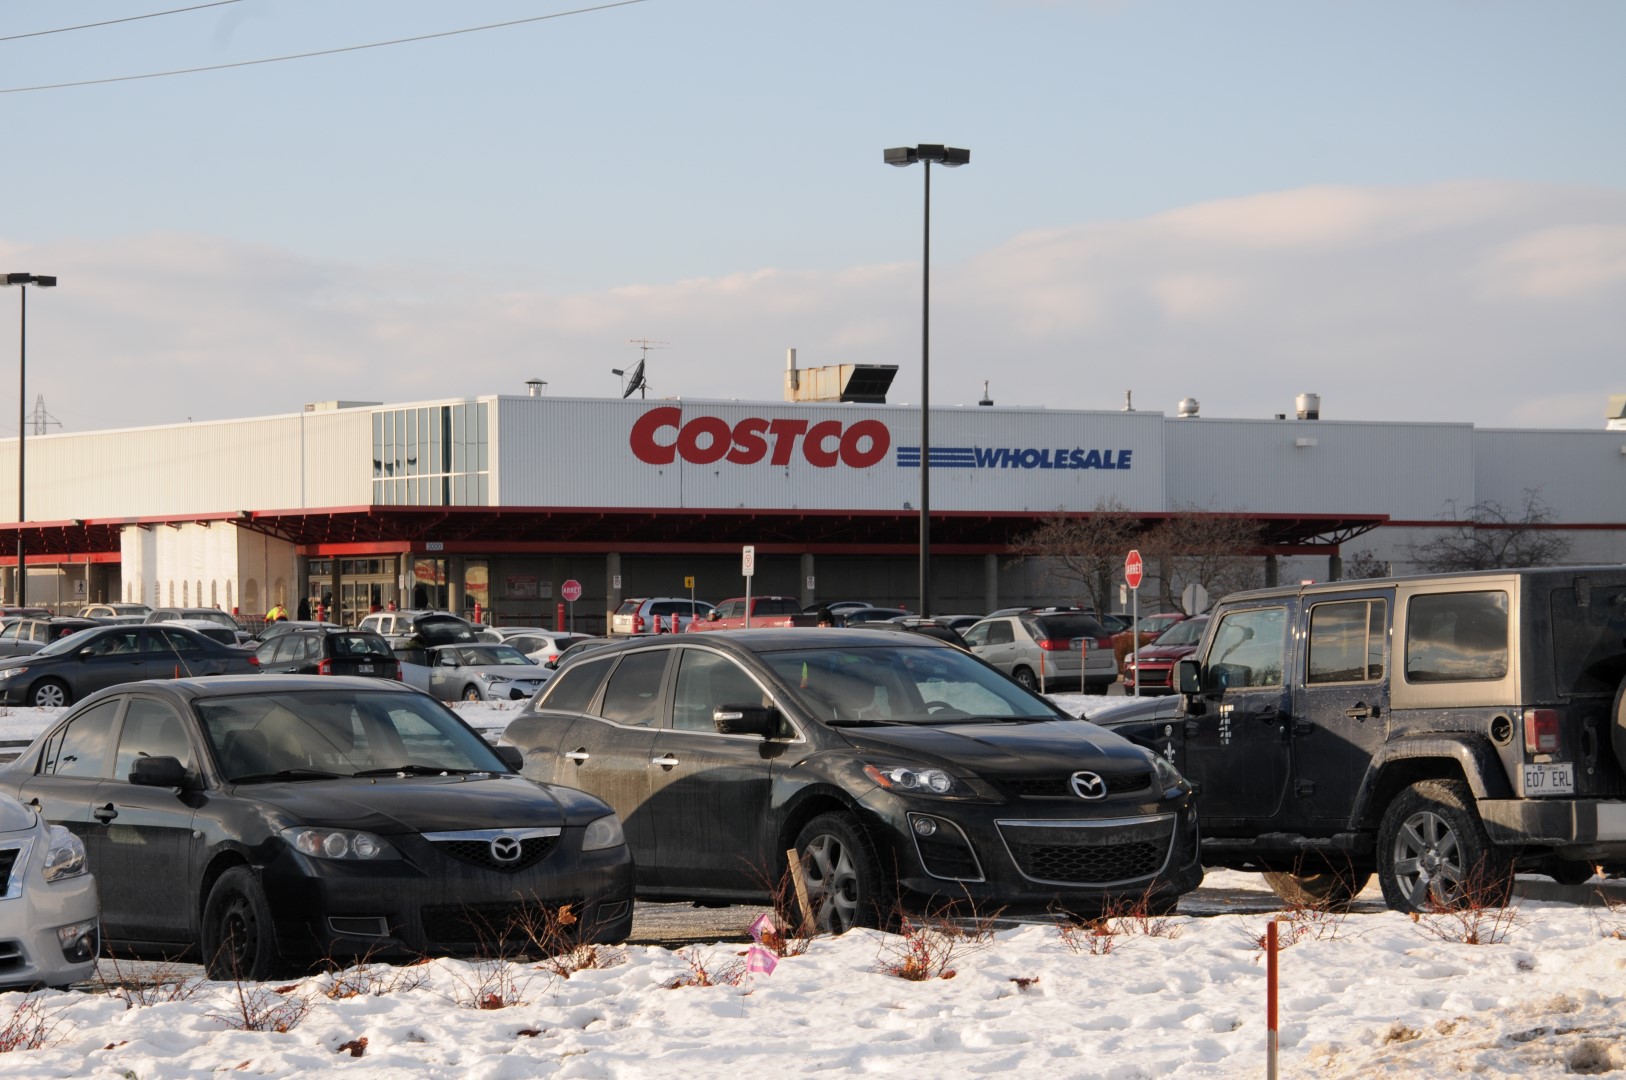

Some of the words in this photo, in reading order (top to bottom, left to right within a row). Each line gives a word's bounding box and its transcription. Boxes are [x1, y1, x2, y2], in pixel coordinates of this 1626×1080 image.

[629, 406, 891, 468] COSTCO
[974, 447, 1132, 469] WHOLESALE
[1126, 562, 1141, 575] ARRÊT
[563, 586, 580, 594] ARRÊT
[1552, 771, 1572, 787] ERL
